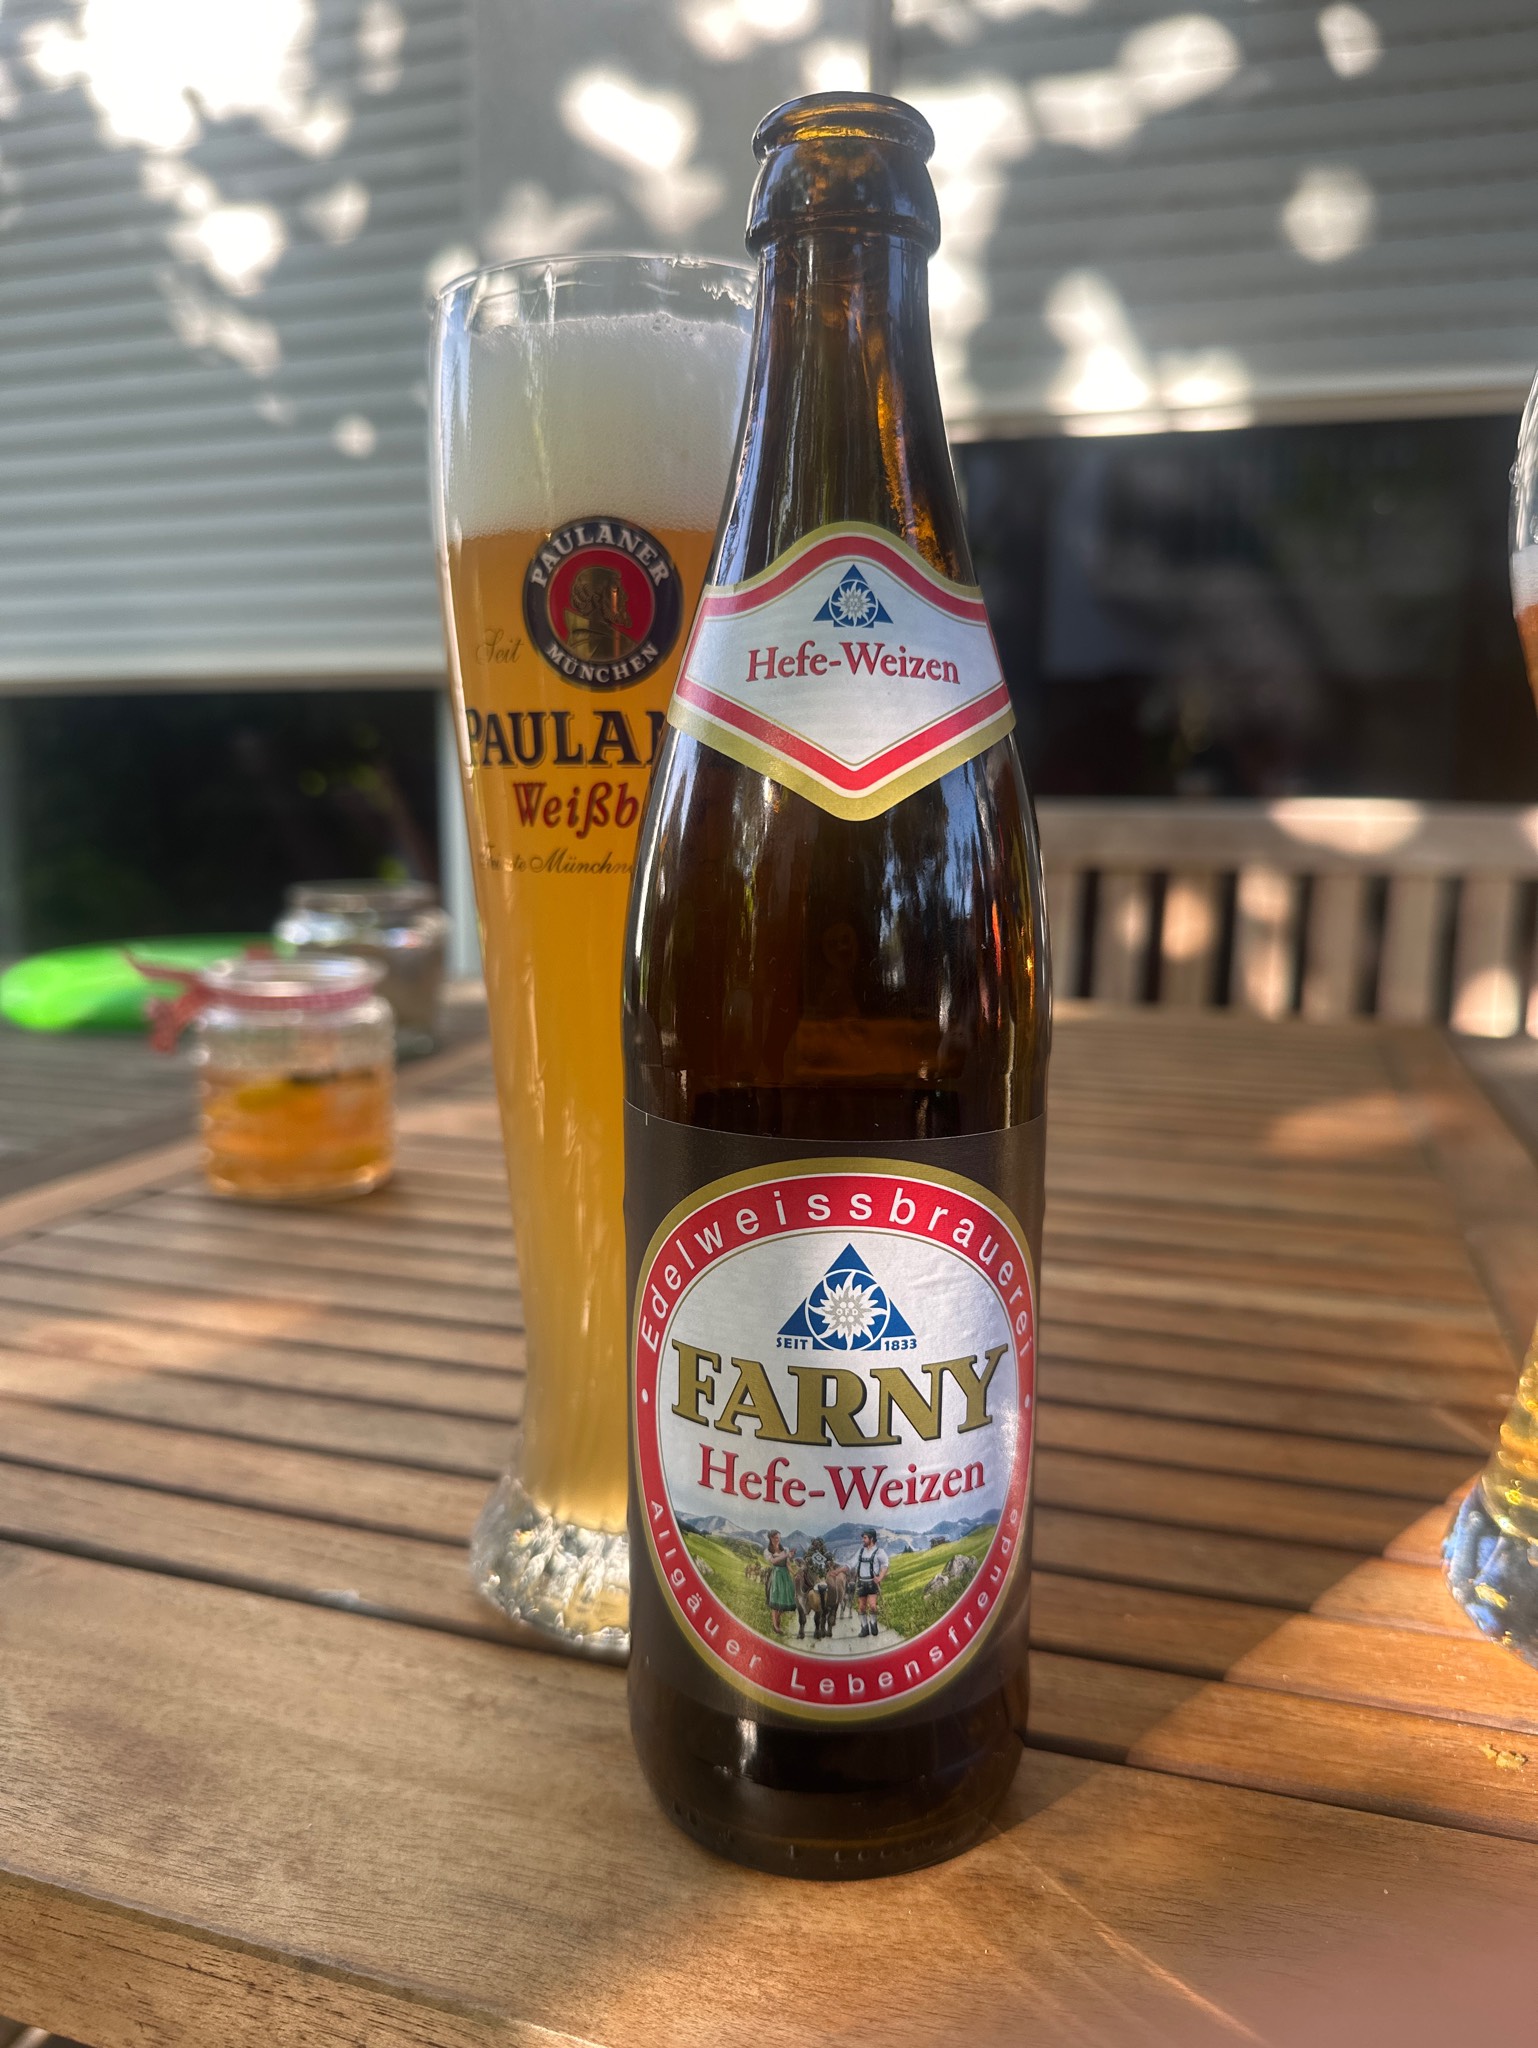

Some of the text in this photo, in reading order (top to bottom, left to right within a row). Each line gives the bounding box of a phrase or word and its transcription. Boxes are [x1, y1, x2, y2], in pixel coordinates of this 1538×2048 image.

[530, 525, 671, 589] PAULANER
[476, 625, 524, 664] Seit
[546, 643, 660, 683] MÜNCHEN
[746, 640, 961, 685] Hefe-Weizen
[641, 1187, 1031, 1357] Edelweissbrauerei
[776, 1337, 918, 1351] SEIT 1833
[672, 1339, 1009, 1447] FARNY
[698, 1443, 986, 1510] Hefe-Weizen
[651, 1500, 1019, 1696] Allgäuer Lebensfreude
